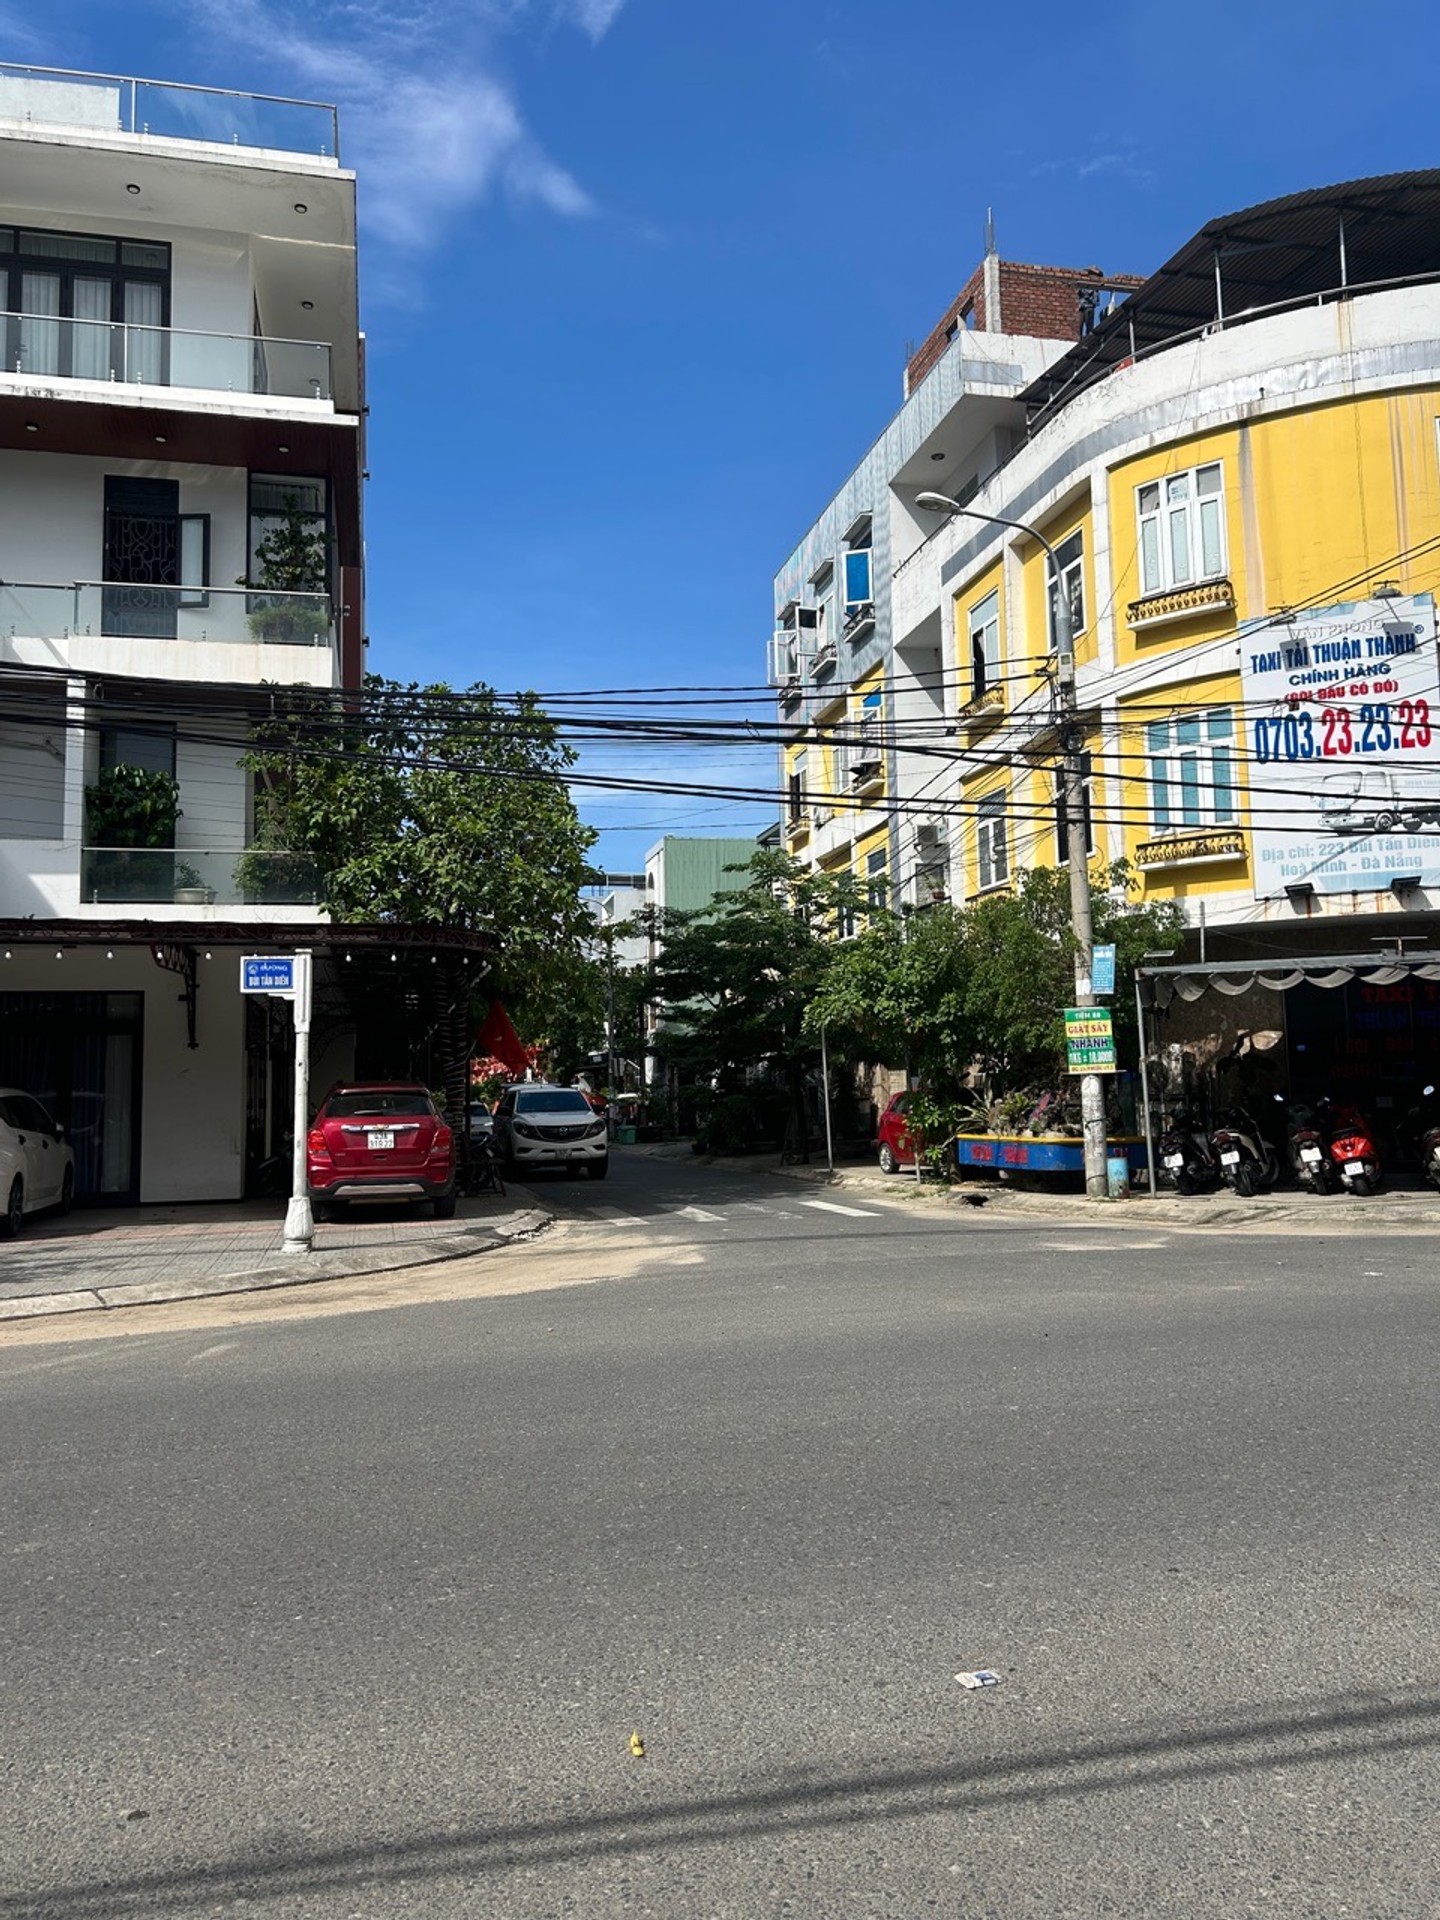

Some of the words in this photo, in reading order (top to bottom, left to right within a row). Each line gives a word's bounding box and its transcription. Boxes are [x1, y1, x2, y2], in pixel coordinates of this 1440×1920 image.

[1250, 651, 1282, 675] TAXI
[1312, 637, 1362, 664] THUẬN
[1366, 632, 1416, 658] THÀNH
[1289, 668, 1339, 686] CHÍNH
[1344, 663, 1392, 680] HÃNG
[1350, 682, 1369, 697] CÓ
[1255, 698, 1432, 764] 0703.23.23.23
[1262, 848, 1285, 864] Địa
[1319, 841, 1344, 857] 223
[1311, 858, 1347, 874] Minh
[1361, 855, 1381, 870] Đà
[1072, 1038, 1108, 1049] NHANH
